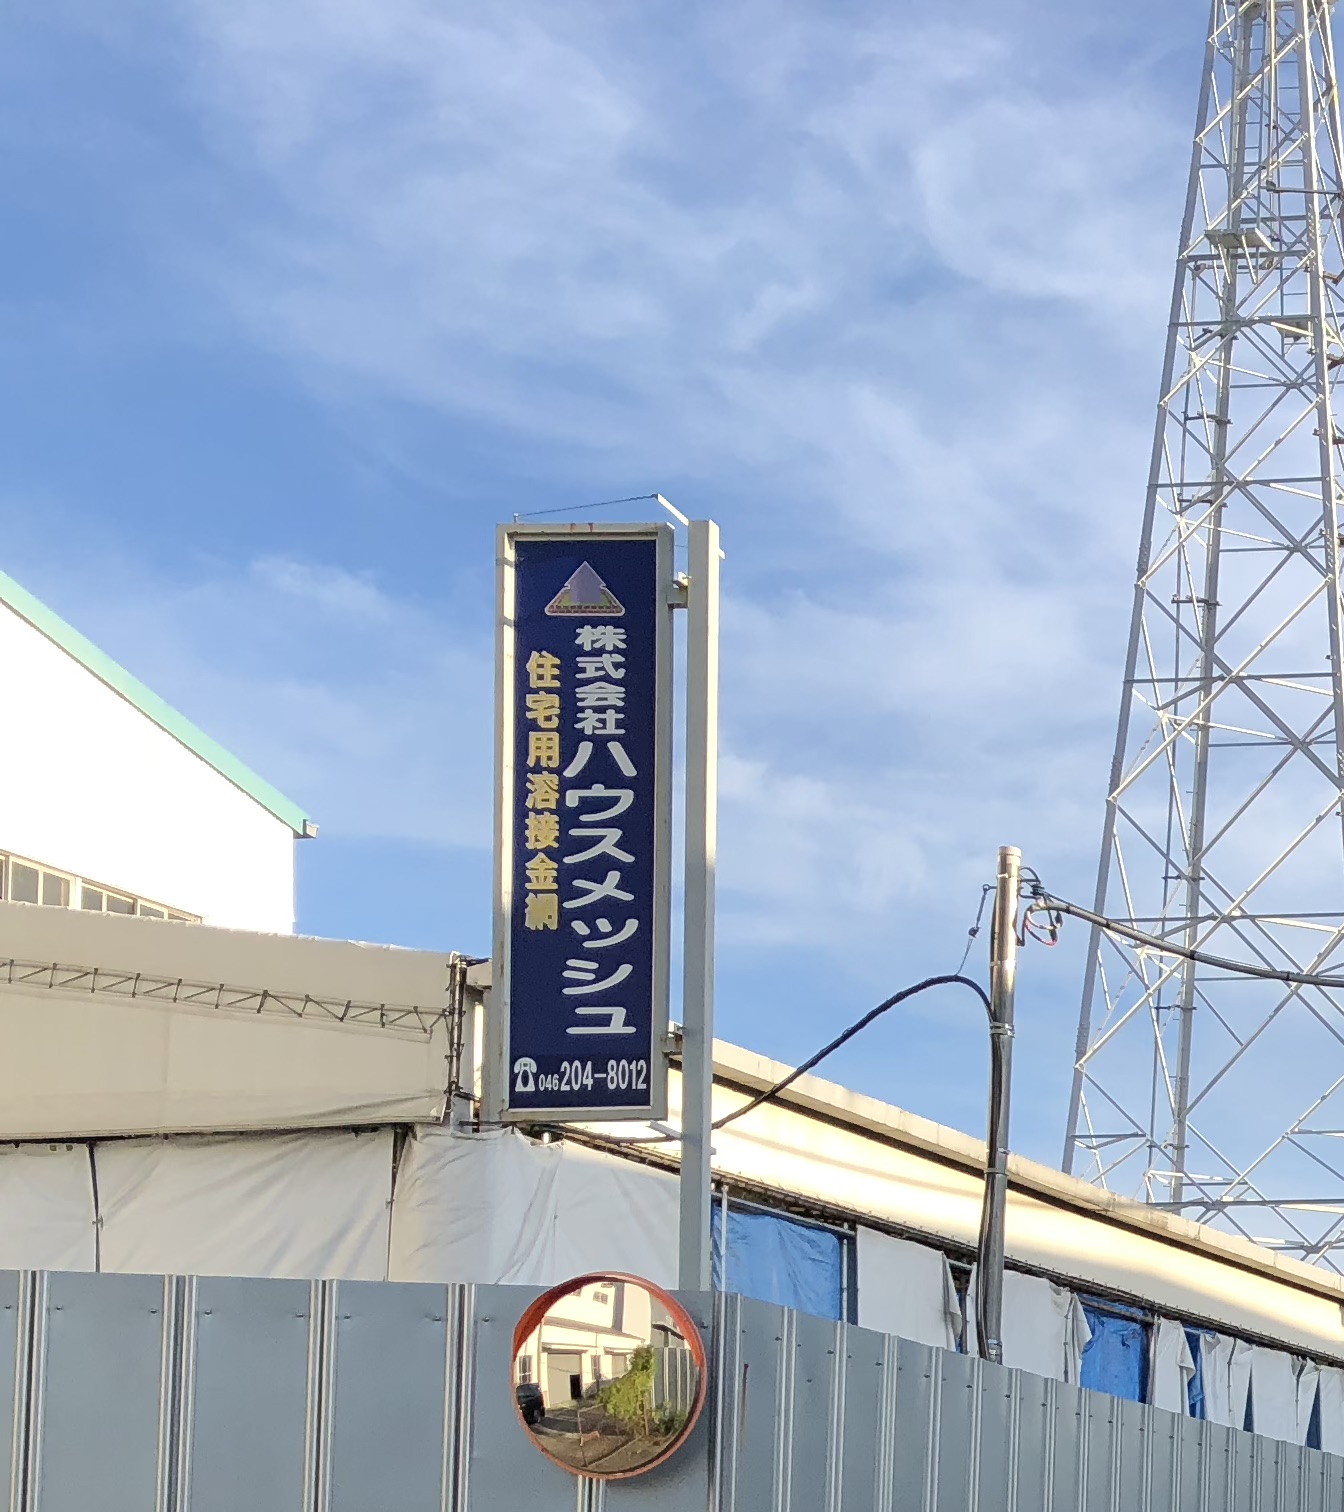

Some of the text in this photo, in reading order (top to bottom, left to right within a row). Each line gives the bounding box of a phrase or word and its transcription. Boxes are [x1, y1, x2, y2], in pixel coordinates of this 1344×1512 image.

[524, 650, 561, 931] 住宅用溶接金網
[562, 624, 639, 1036] 株式会社ハウスメッシュ
